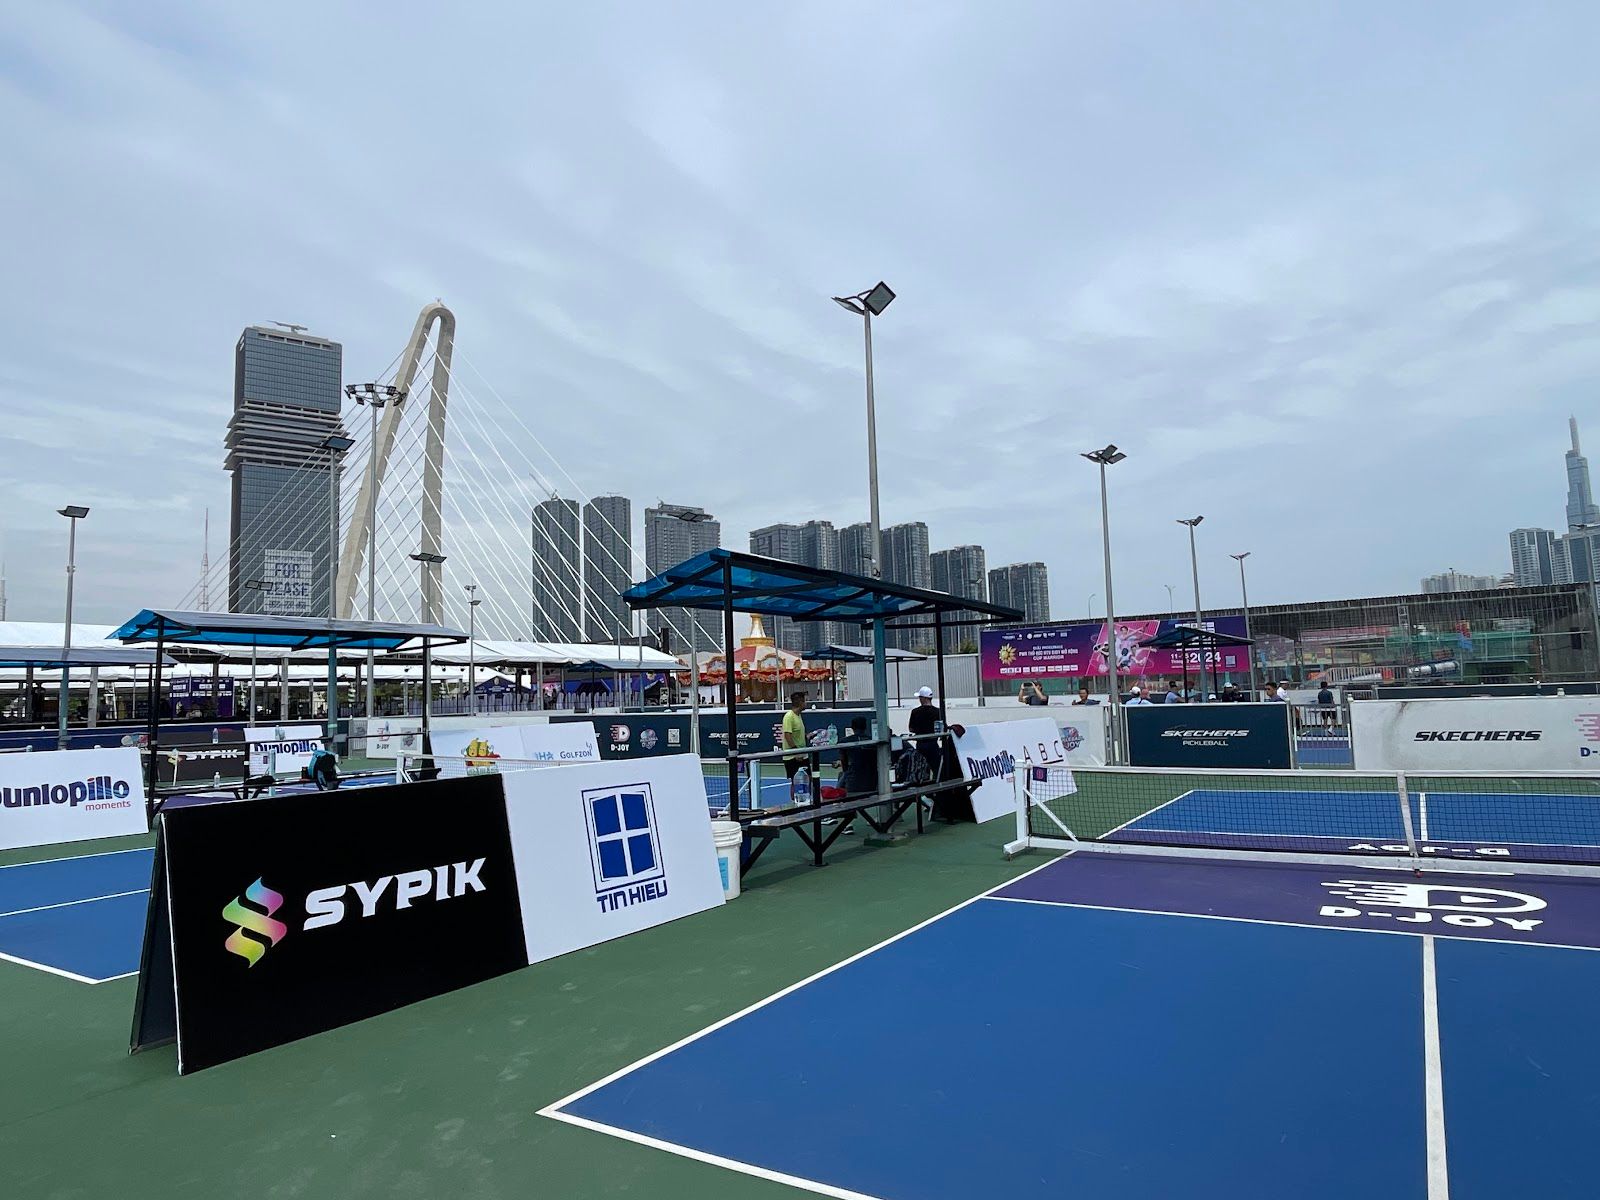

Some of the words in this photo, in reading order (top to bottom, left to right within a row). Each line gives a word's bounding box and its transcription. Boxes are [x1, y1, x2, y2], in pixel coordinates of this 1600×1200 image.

[1413, 730, 1543, 742] SKECHERS
[560, 749, 593, 759] GOLFZON
[966, 749, 1016, 780] Dunlopillo
[0, 776, 130, 808] unlopillo
[85, 799, 131, 811] moments
[303, 857, 487, 931] SYPIK
[1319, 905, 1544, 931] D-JOY
